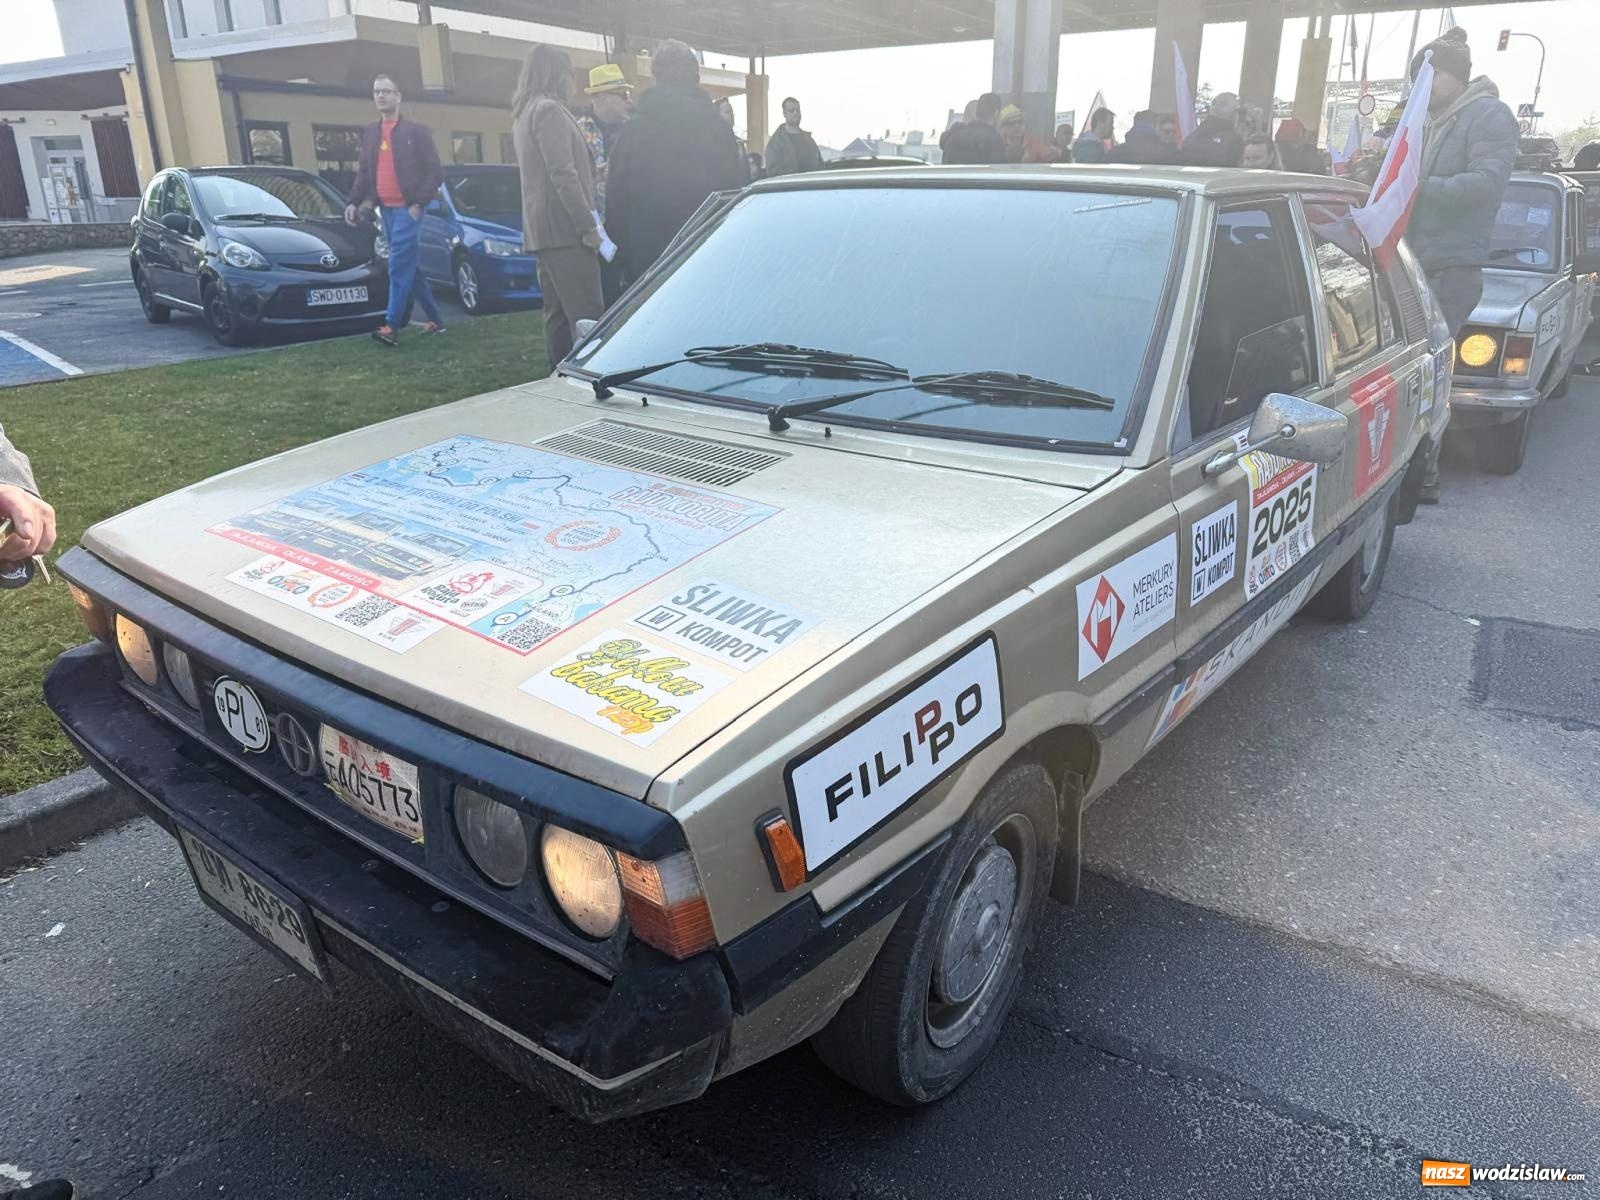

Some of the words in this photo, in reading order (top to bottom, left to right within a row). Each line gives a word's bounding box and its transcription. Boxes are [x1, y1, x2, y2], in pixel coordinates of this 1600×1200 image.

[311, 289, 334, 302] SWD
[336, 287, 367, 300] 01130
[1194, 512, 1236, 567] ŚLIWKA
[1252, 478, 1312, 558] 2025
[1132, 560, 1175, 599] MERKURY
[1207, 552, 1234, 588] KOMPOT
[671, 583, 802, 645] ŚLIWKA
[1132, 581, 1175, 621] ATELIERS
[650, 611, 674, 625] W
[676, 621, 768, 664] KOMPOT
[217, 695, 226, 712] 19
[224, 687, 257, 742] PL
[255, 717, 264, 735] 81
[824, 682, 983, 823] FILIPPO
